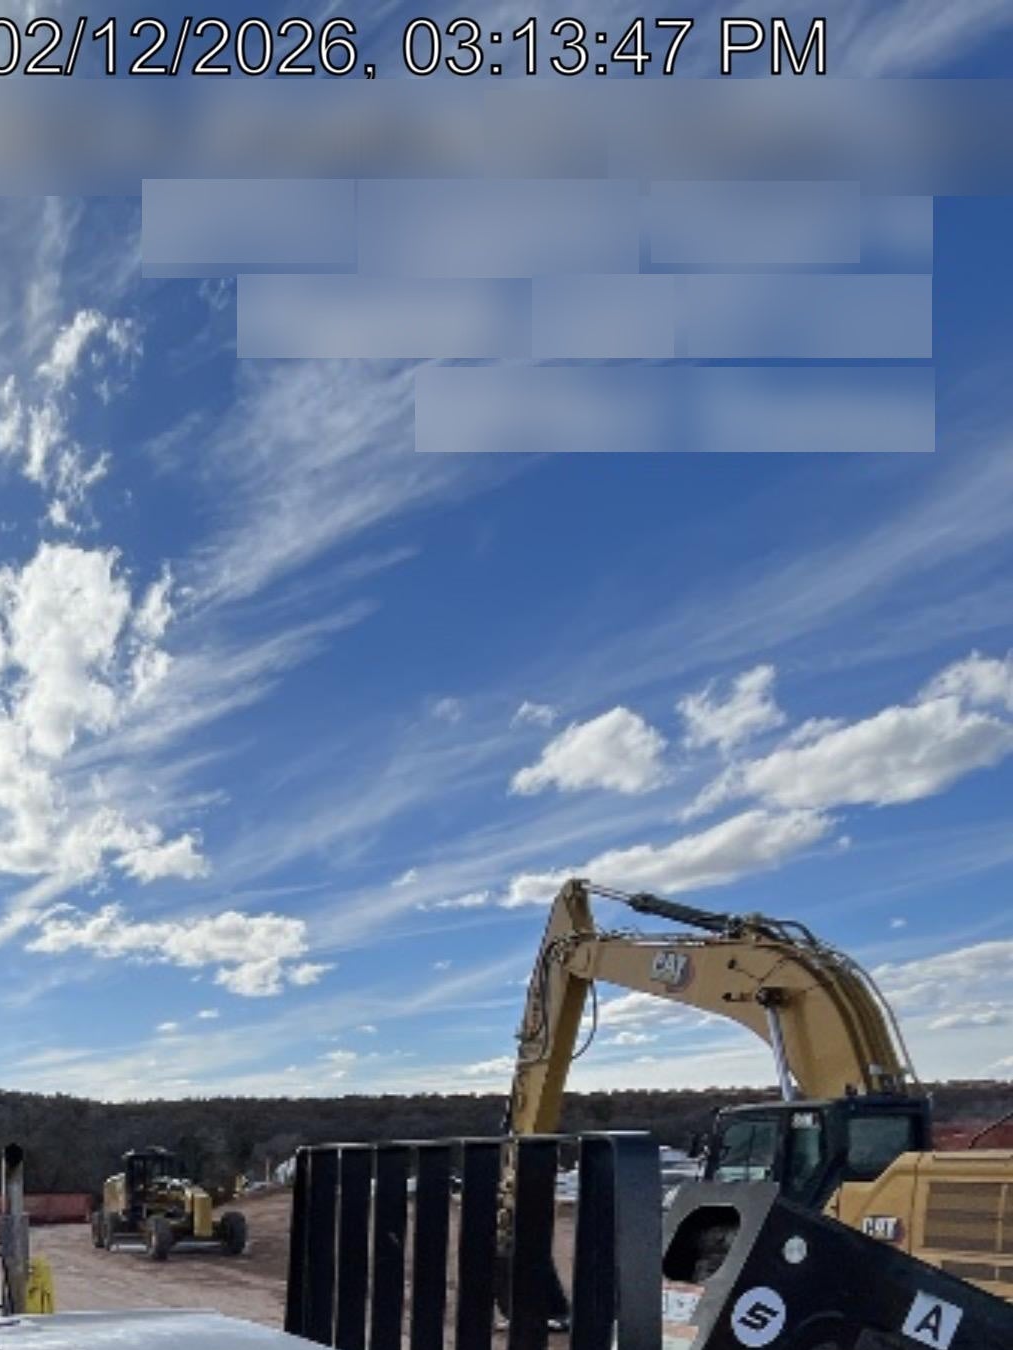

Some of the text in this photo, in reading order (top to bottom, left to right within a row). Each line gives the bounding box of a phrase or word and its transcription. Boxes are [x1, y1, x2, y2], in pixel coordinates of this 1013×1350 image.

[652, 952, 688, 983] CAT
[862, 1217, 897, 1240] CAT
[914, 1303, 943, 1341] A
